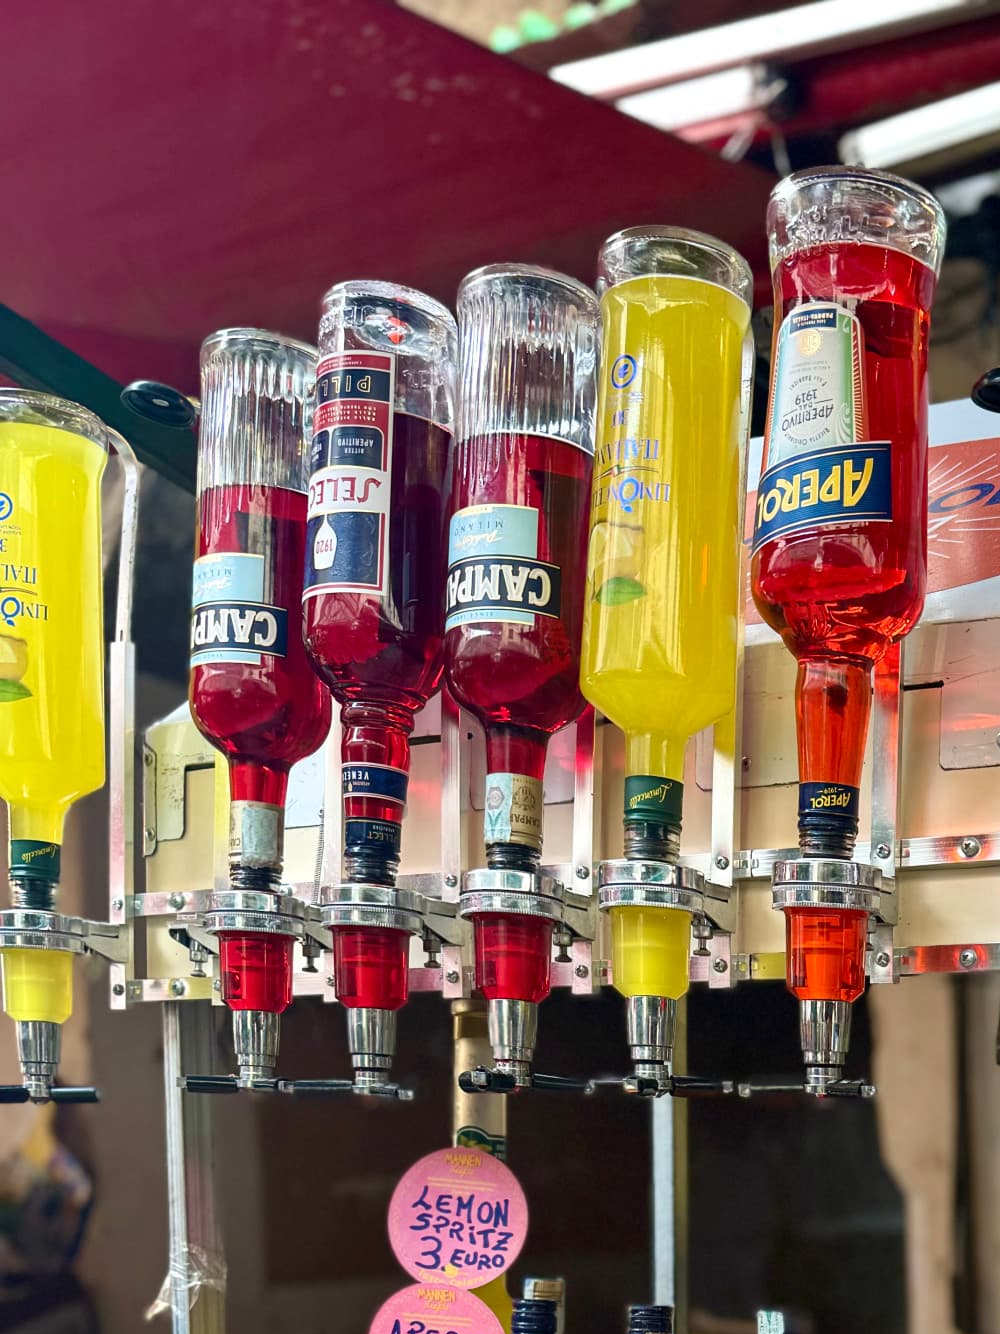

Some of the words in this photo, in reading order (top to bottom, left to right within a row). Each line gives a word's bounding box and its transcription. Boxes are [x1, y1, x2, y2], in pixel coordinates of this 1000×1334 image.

[795, 389, 818, 405] 1919
[782, 404, 834, 431] APERITIVO
[337, 438, 374, 447] APERITIVO
[758, 458, 874, 529] APEROL
[315, 539, 334, 554] 1920
[447, 565, 551, 607] CAMPA
[810, 792, 851, 808] APEROL
[411, 1185, 509, 1229] LEMON
[450, 1249, 506, 1270] EURO
